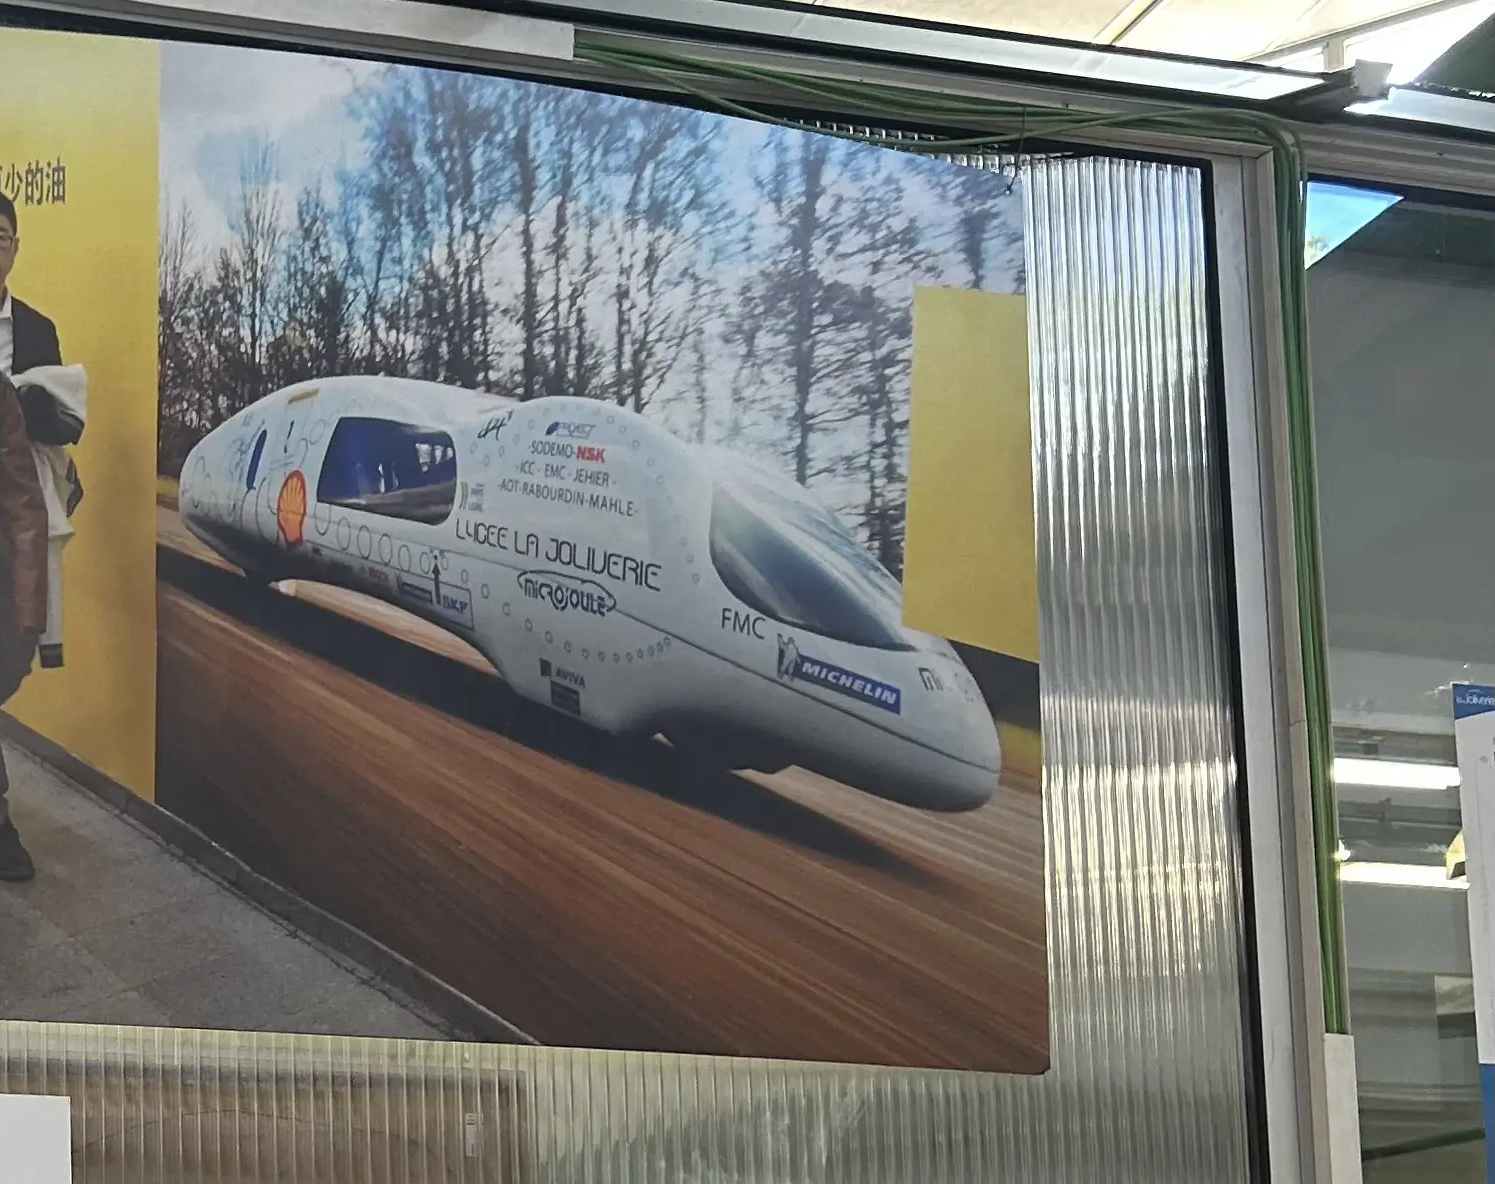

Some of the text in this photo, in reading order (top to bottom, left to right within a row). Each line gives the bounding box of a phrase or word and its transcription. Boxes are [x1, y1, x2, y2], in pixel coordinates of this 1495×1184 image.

[514, 530, 539, 558] LA
[545, 537, 662, 592] JOLIVERIE
[721, 607, 766, 640] FMC
[801, 662, 898, 706] MICHELIN
